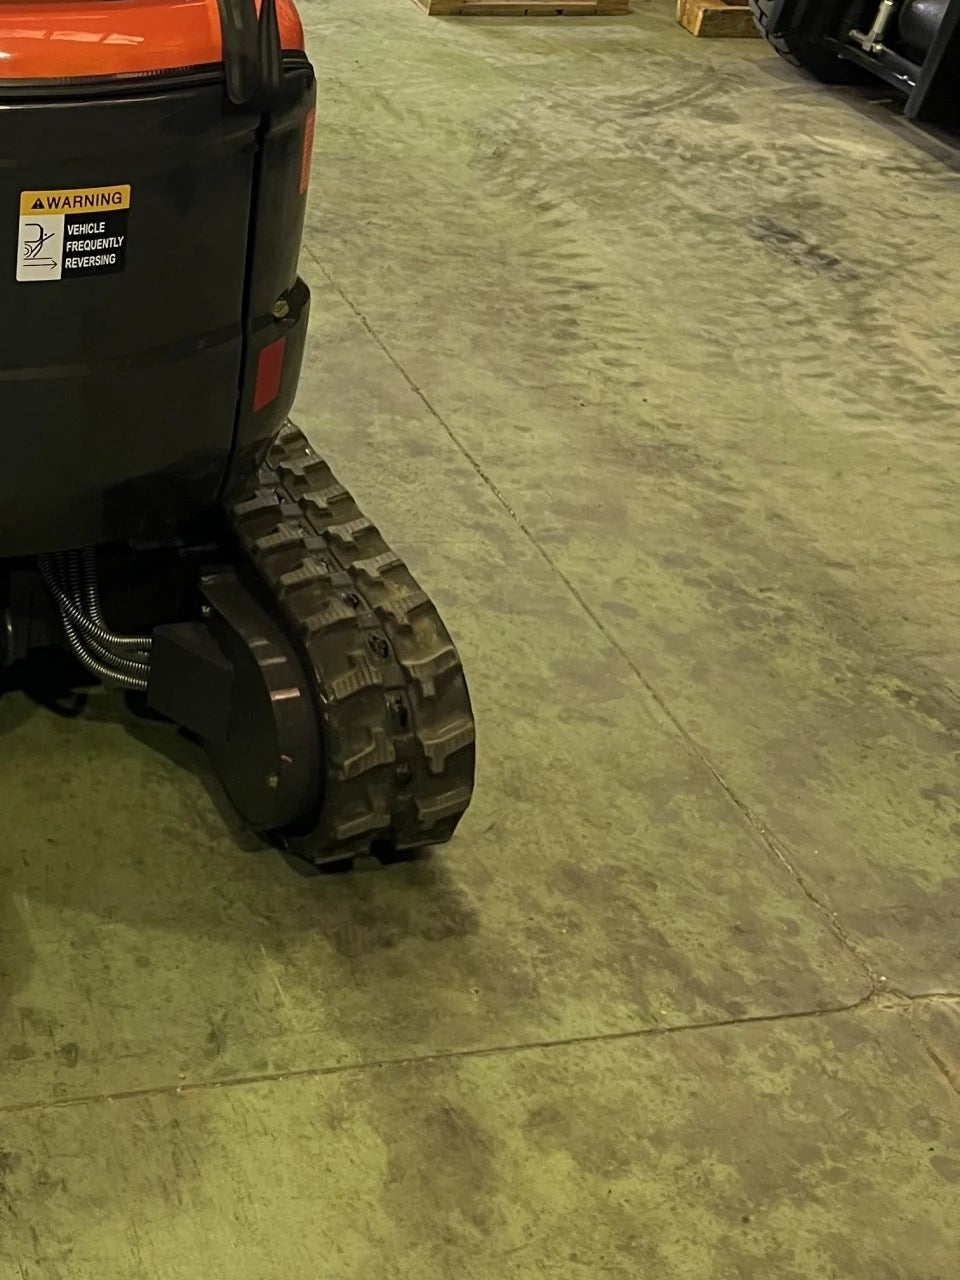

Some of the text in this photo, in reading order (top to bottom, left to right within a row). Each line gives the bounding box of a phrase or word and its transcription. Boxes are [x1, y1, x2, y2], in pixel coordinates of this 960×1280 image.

[46, 191, 122, 209] WARNING
[67, 222, 105, 235] VEHICLE
[66, 236, 124, 252] FREQUENTLY
[65, 254, 116, 269] REVERSING
